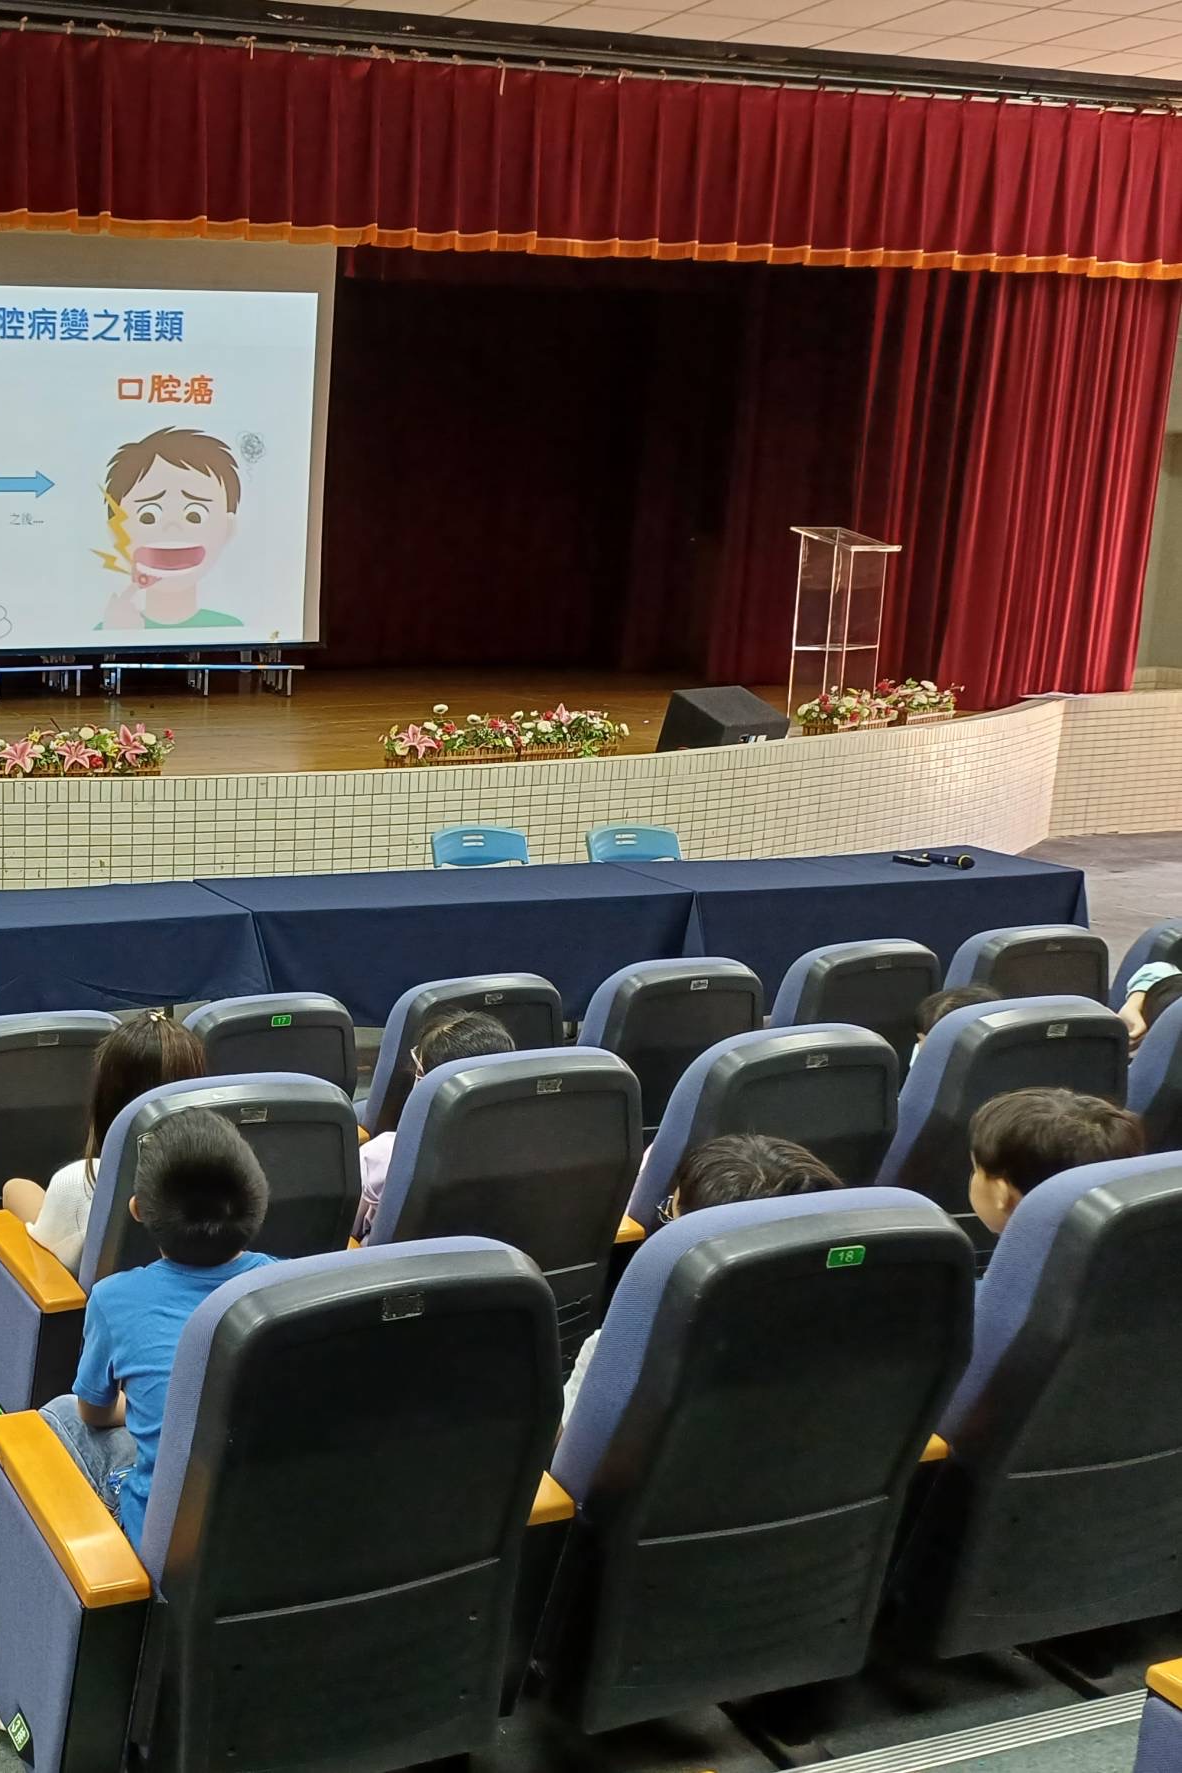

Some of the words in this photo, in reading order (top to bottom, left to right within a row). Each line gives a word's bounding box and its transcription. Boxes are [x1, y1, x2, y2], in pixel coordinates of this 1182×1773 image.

[118, 374, 214, 405] 口腔癌
[838, 1250, 855, 1263] 18
